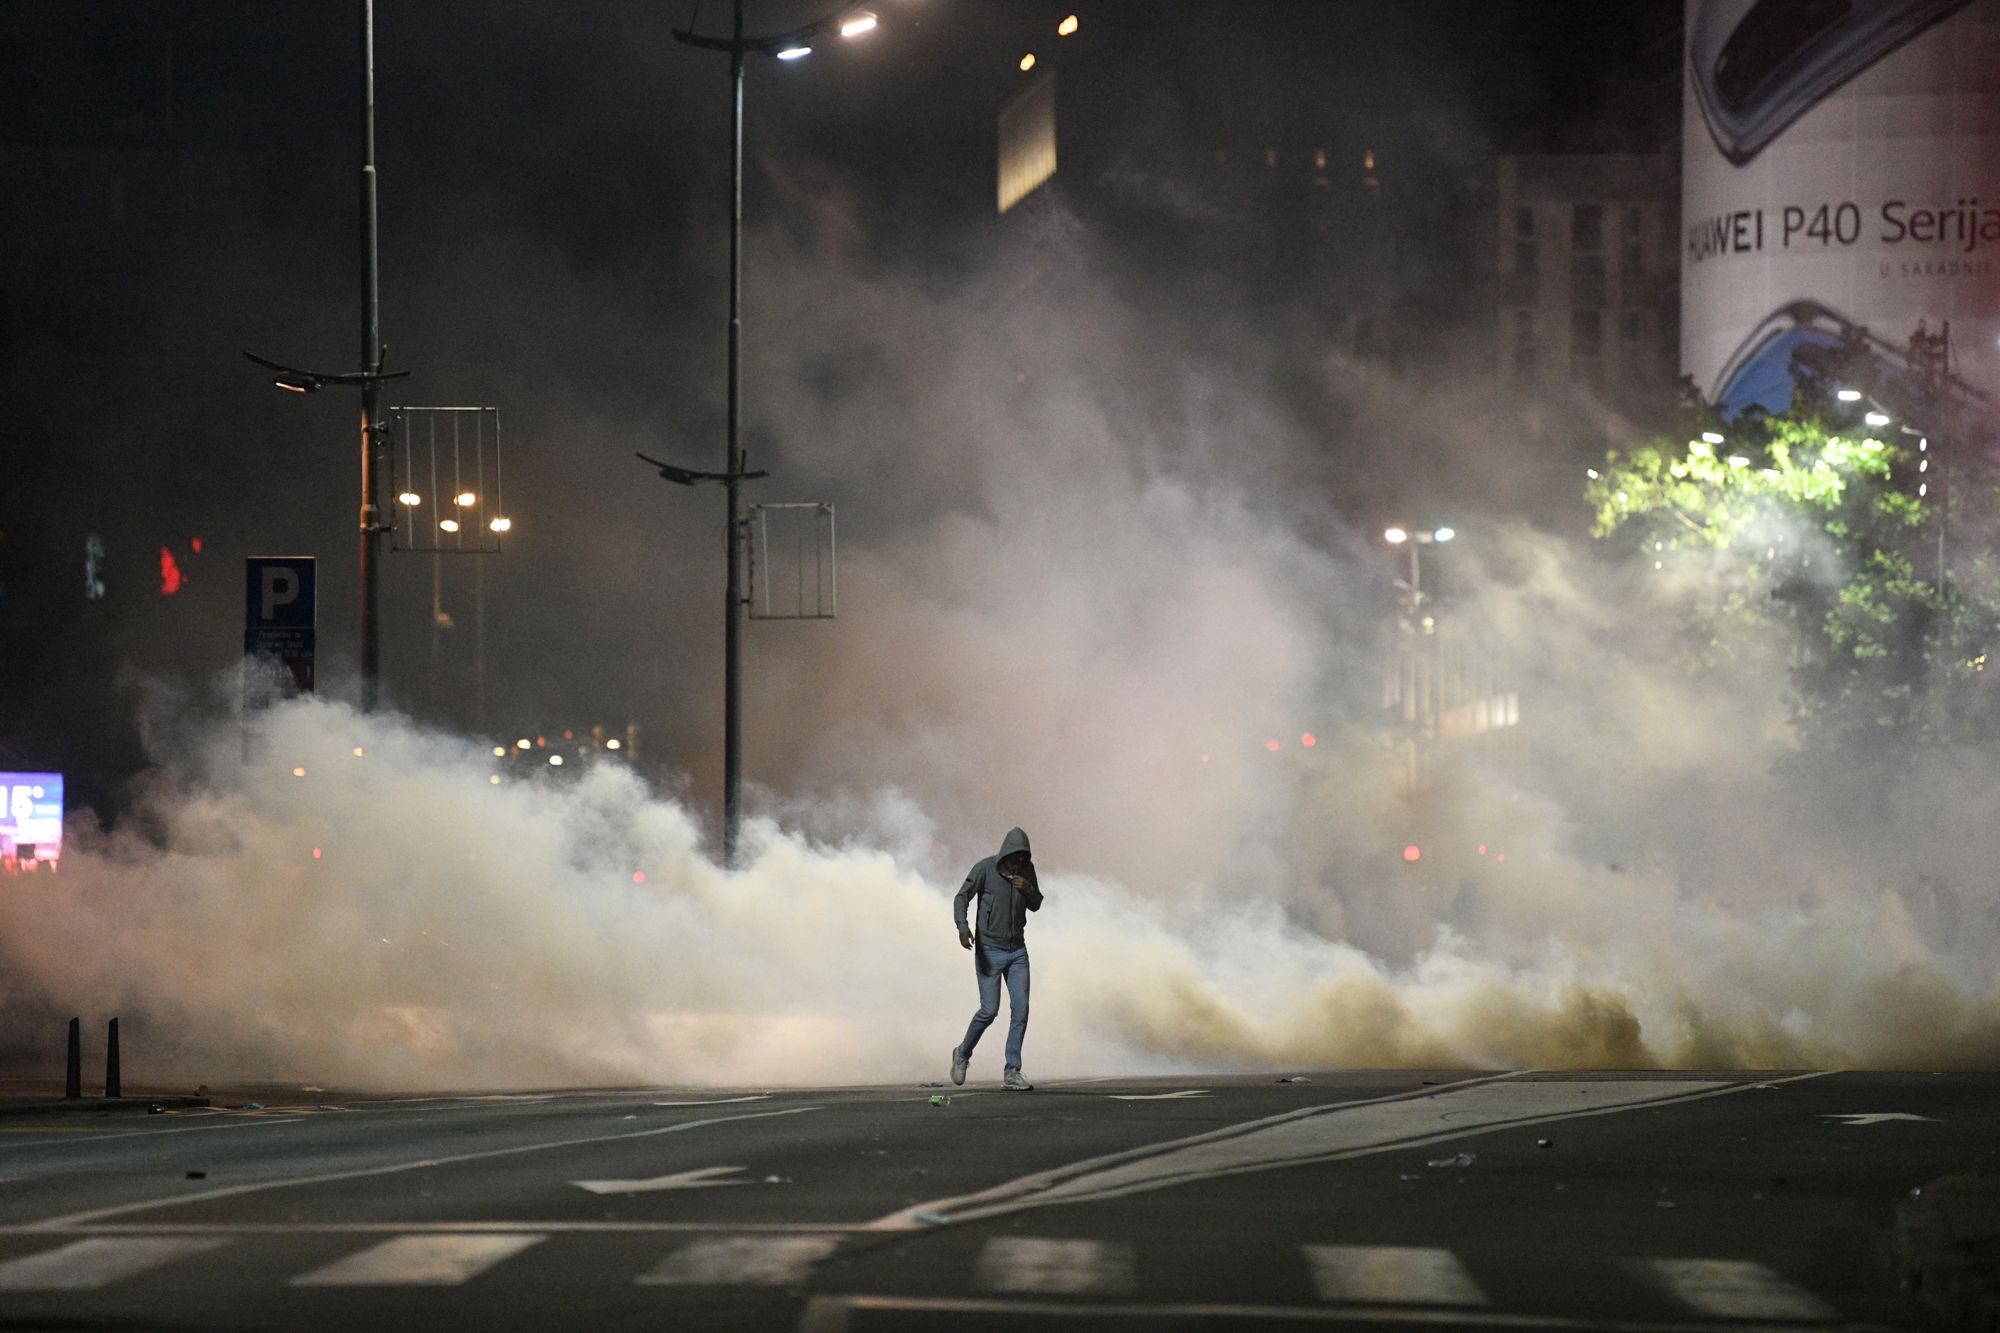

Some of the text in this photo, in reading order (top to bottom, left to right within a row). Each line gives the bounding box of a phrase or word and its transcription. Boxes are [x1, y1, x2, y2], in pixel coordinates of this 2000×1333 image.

[1783, 201, 1861, 248] P40
[1881, 198, 2000, 252] Serija
[262, 566, 299, 619] P
